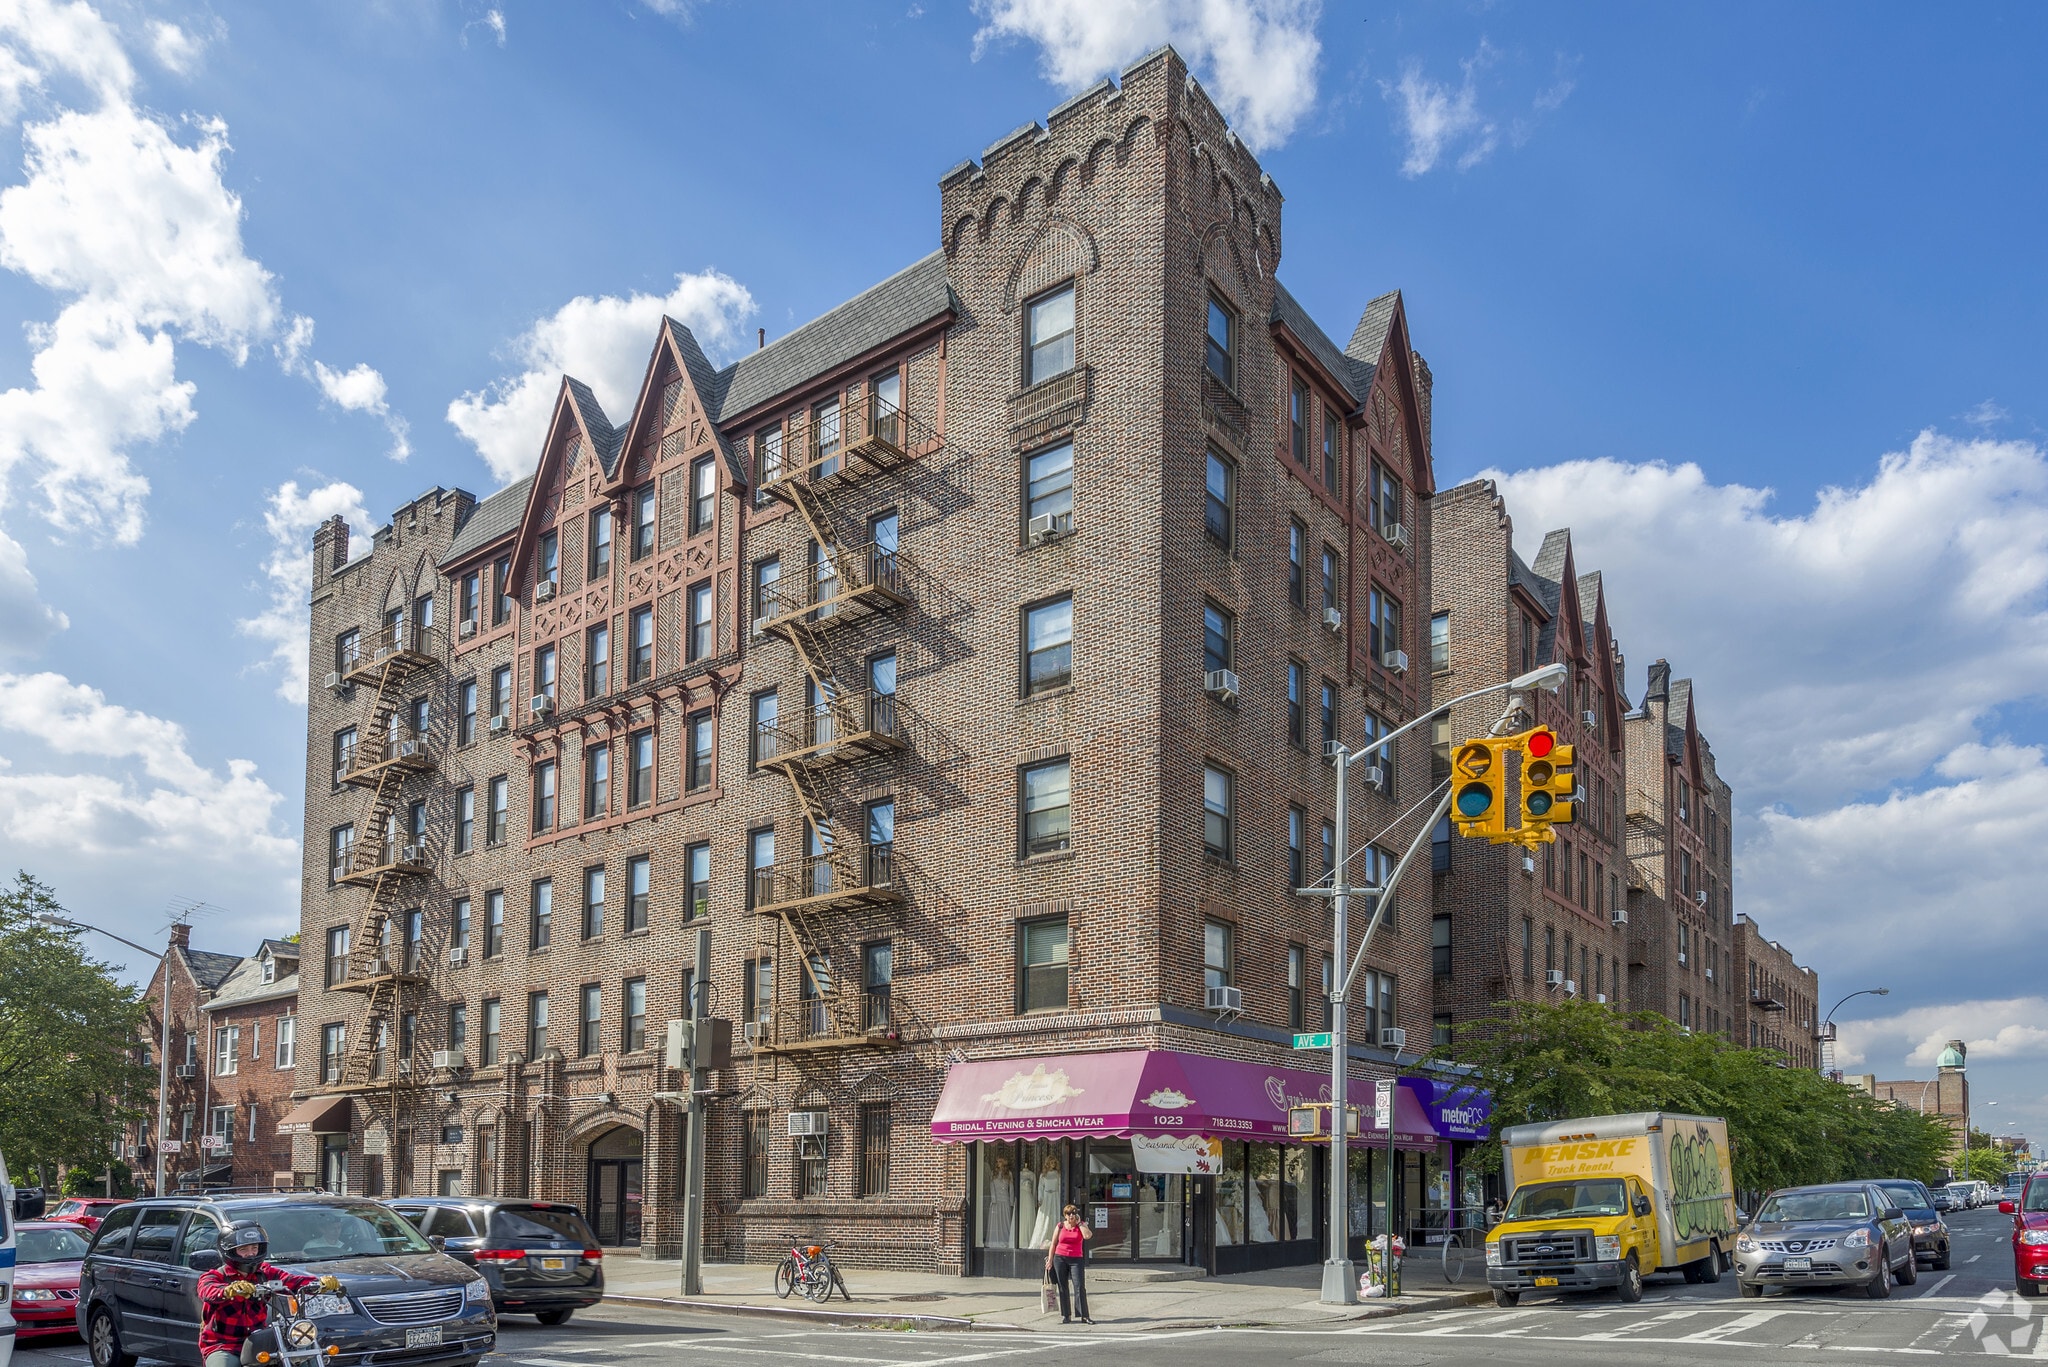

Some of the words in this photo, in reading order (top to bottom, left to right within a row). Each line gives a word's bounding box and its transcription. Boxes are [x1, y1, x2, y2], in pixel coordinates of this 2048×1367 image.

[1298, 1036, 1315, 1047] AVE
[1323, 1035, 1328, 1046] J
[1153, 1116, 1184, 1125] 1023
[1442, 1107, 1483, 1126] metroPCS
[986, 1121, 1025, 1130] EVENING
[1026, 1120, 1034, 1128] &
[1036, 1118, 1072, 1128] SIMCHA
[1074, 1117, 1104, 1126] WEAR
[1212, 1118, 1253, 1130] 718.233.3353
[1179, 1137, 1200, 1151] Sale
[1523, 1139, 1636, 1165] PENSKE
[1548, 1165, 1575, 1175] Truck
[1579, 1161, 1612, 1173] Rental
